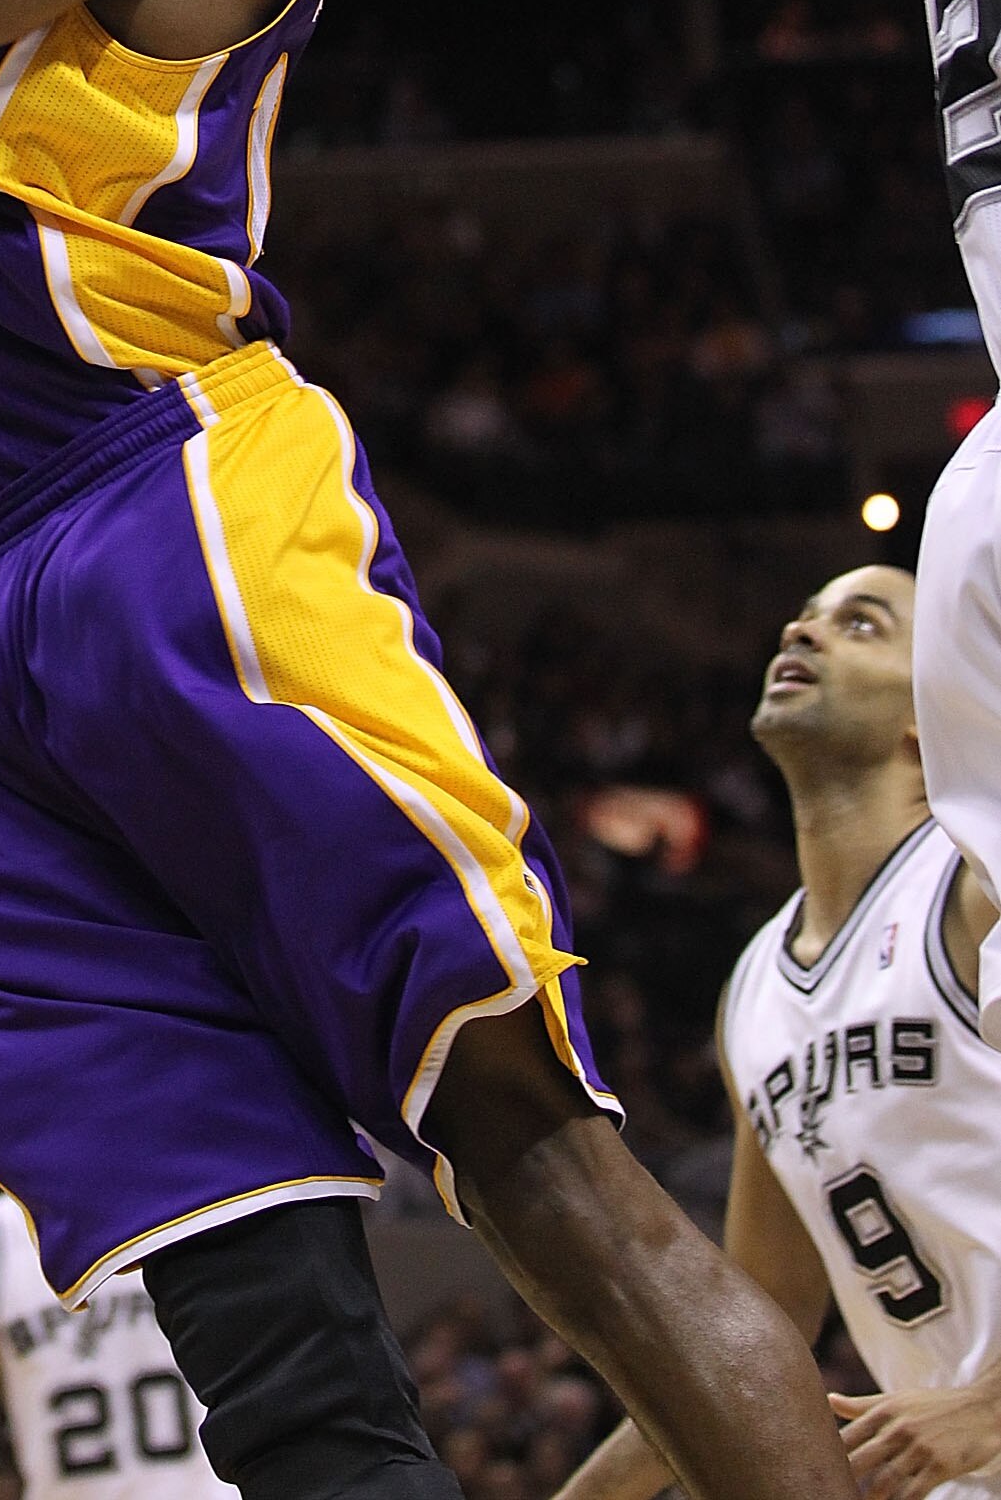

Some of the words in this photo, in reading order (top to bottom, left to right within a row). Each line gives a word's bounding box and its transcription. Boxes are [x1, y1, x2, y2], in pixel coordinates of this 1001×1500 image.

[746, 1018, 939, 1160] SPURS
[825, 1163, 947, 1329] 9
[48, 1368, 194, 1479] 20
